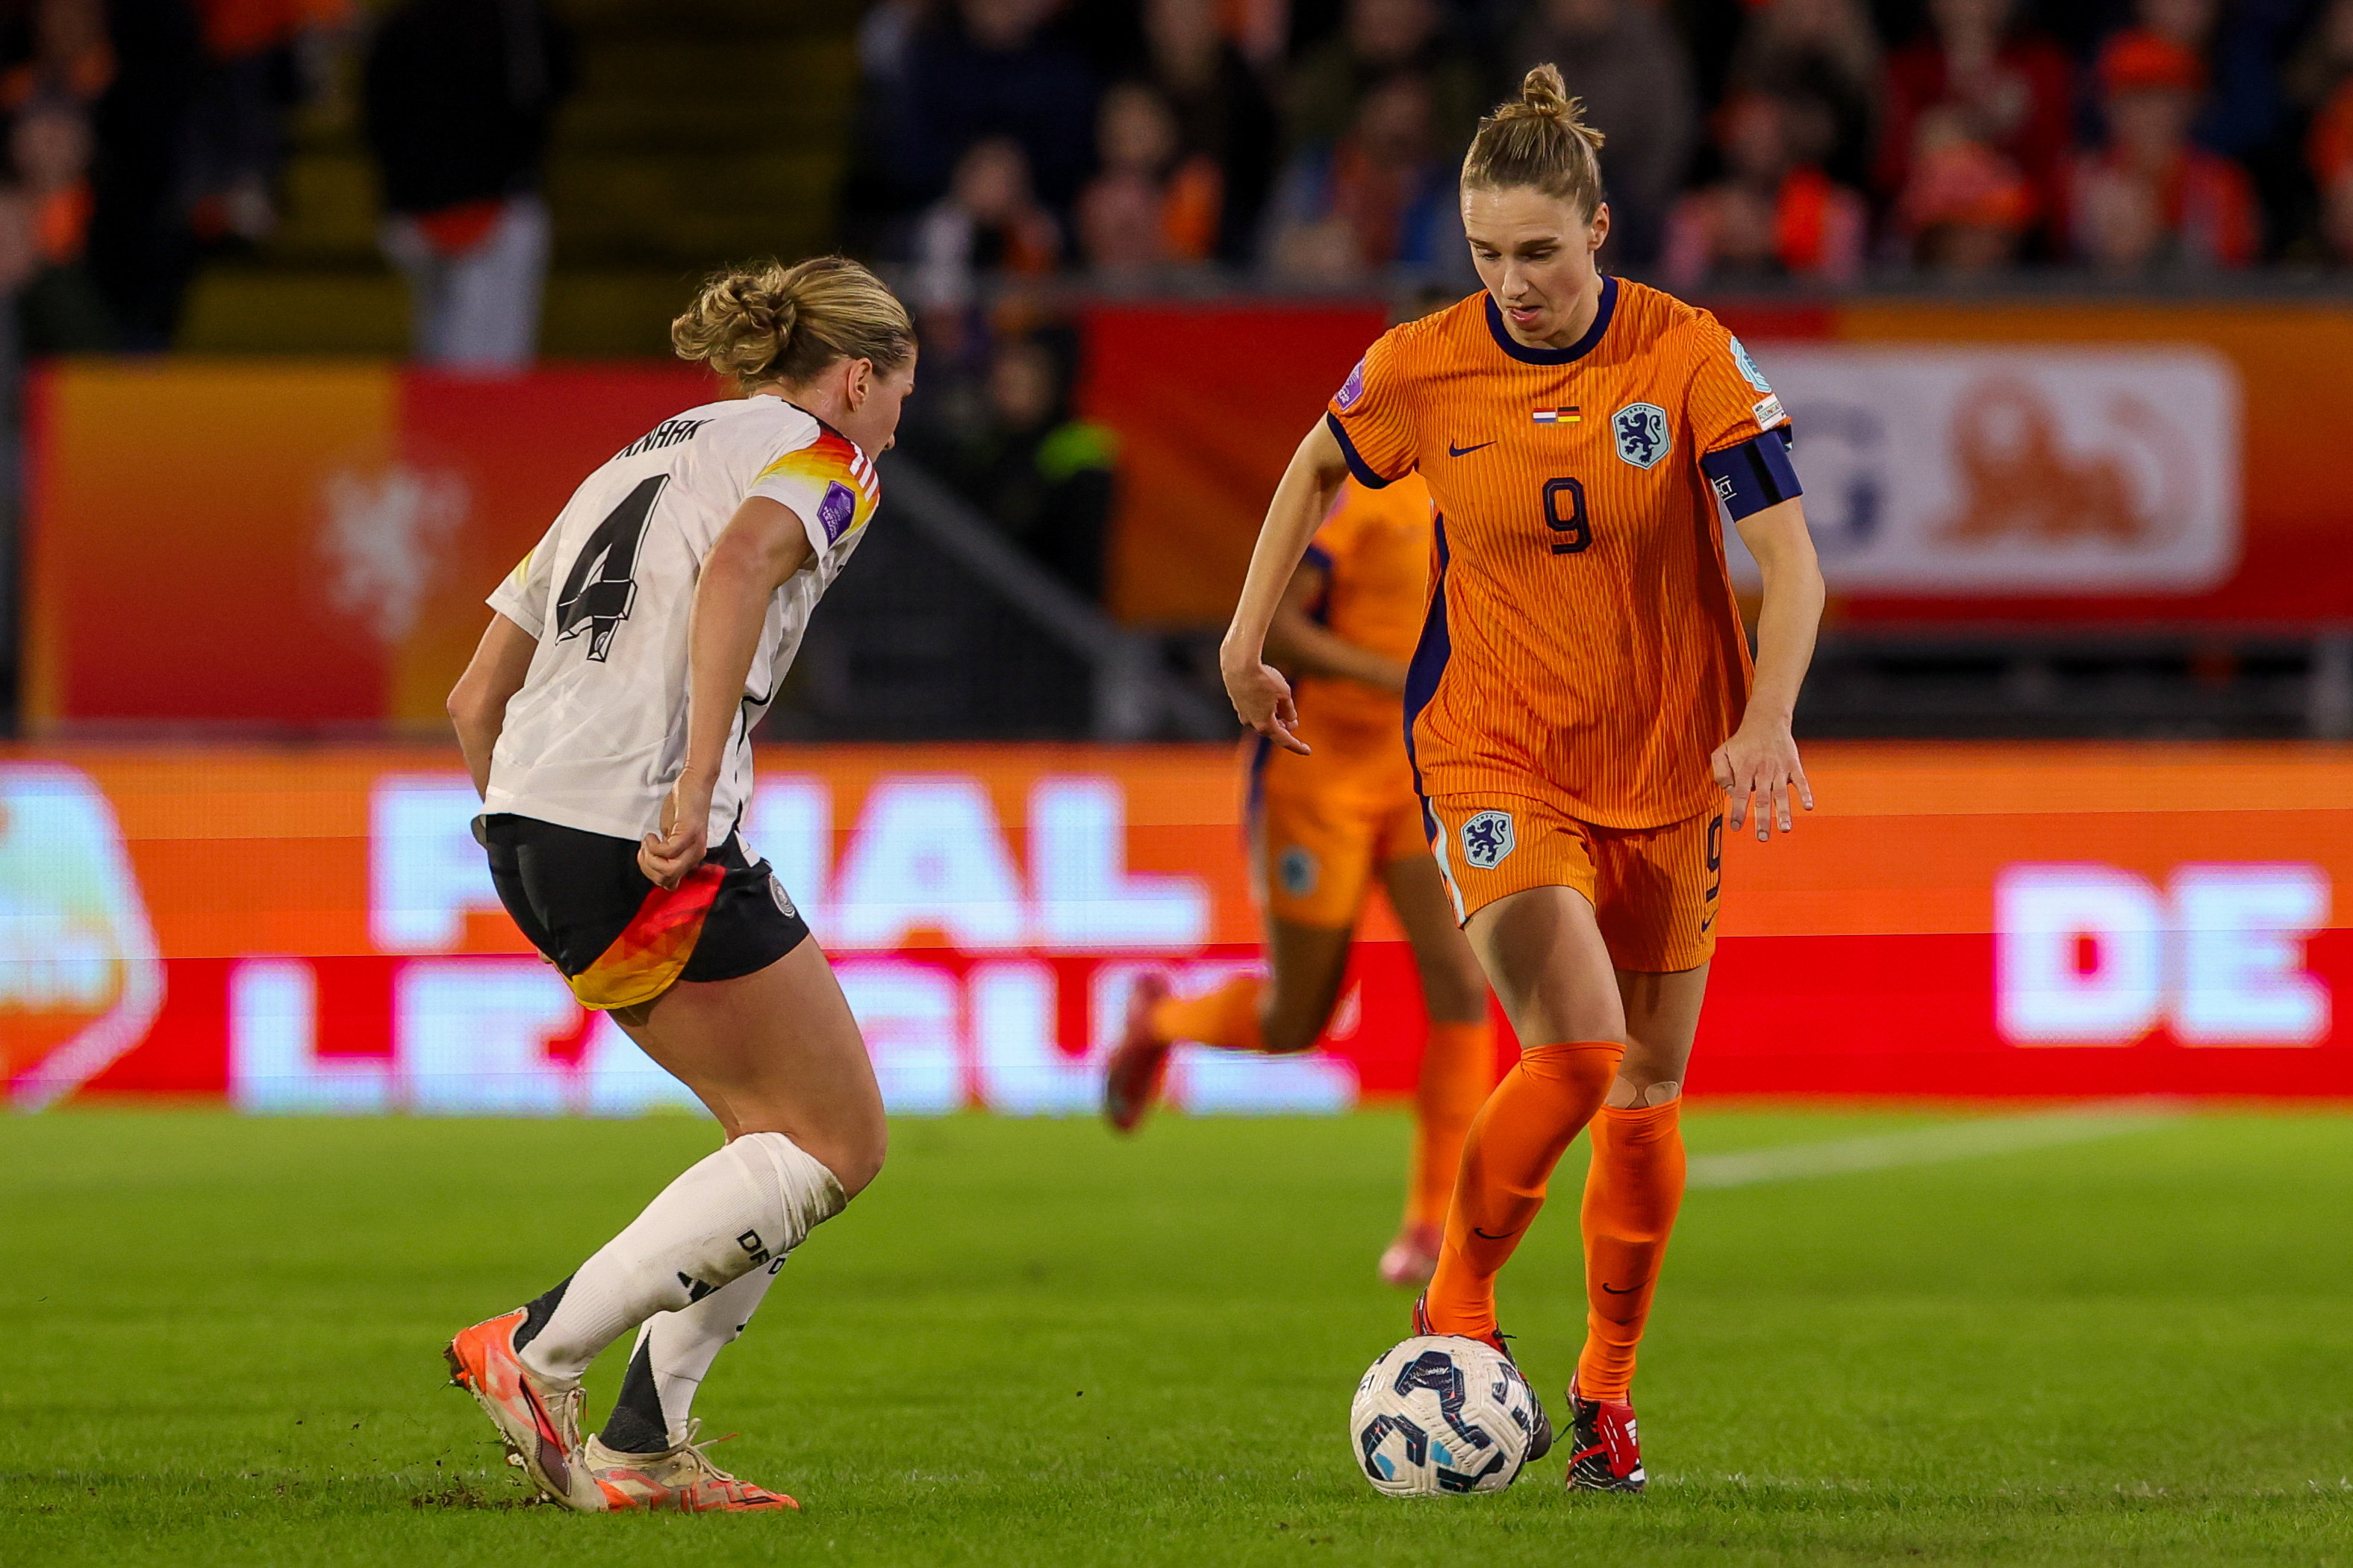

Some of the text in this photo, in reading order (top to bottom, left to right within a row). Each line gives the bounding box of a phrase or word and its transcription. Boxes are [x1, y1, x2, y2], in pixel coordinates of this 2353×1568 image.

[555, 473, 670, 663] 4
[1542, 477, 1592, 555] 9
[367, 773, 1211, 954] FAL
[1706, 813, 1723, 903] 9
[1995, 863, 2331, 1047] DE
